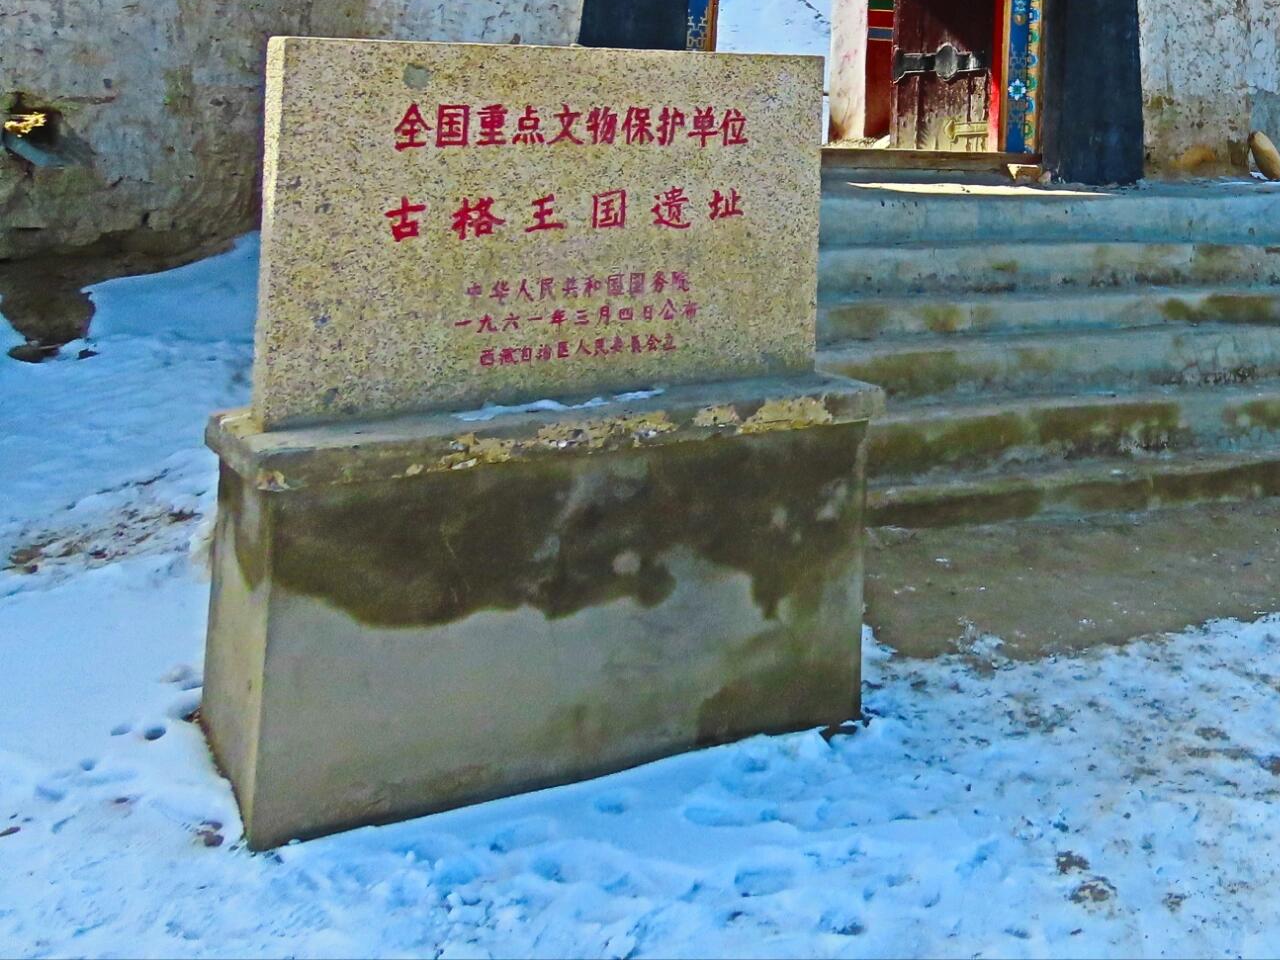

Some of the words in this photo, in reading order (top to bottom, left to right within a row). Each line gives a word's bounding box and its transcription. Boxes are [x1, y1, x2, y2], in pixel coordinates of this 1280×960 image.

[394, 103, 748, 150] 全国重点文物保护单位
[385, 186, 745, 243] 古格王国遗址
[466, 271, 690, 307] 中华人民共和国国务院
[454, 298, 700, 333] 一九六一年三月四日公布
